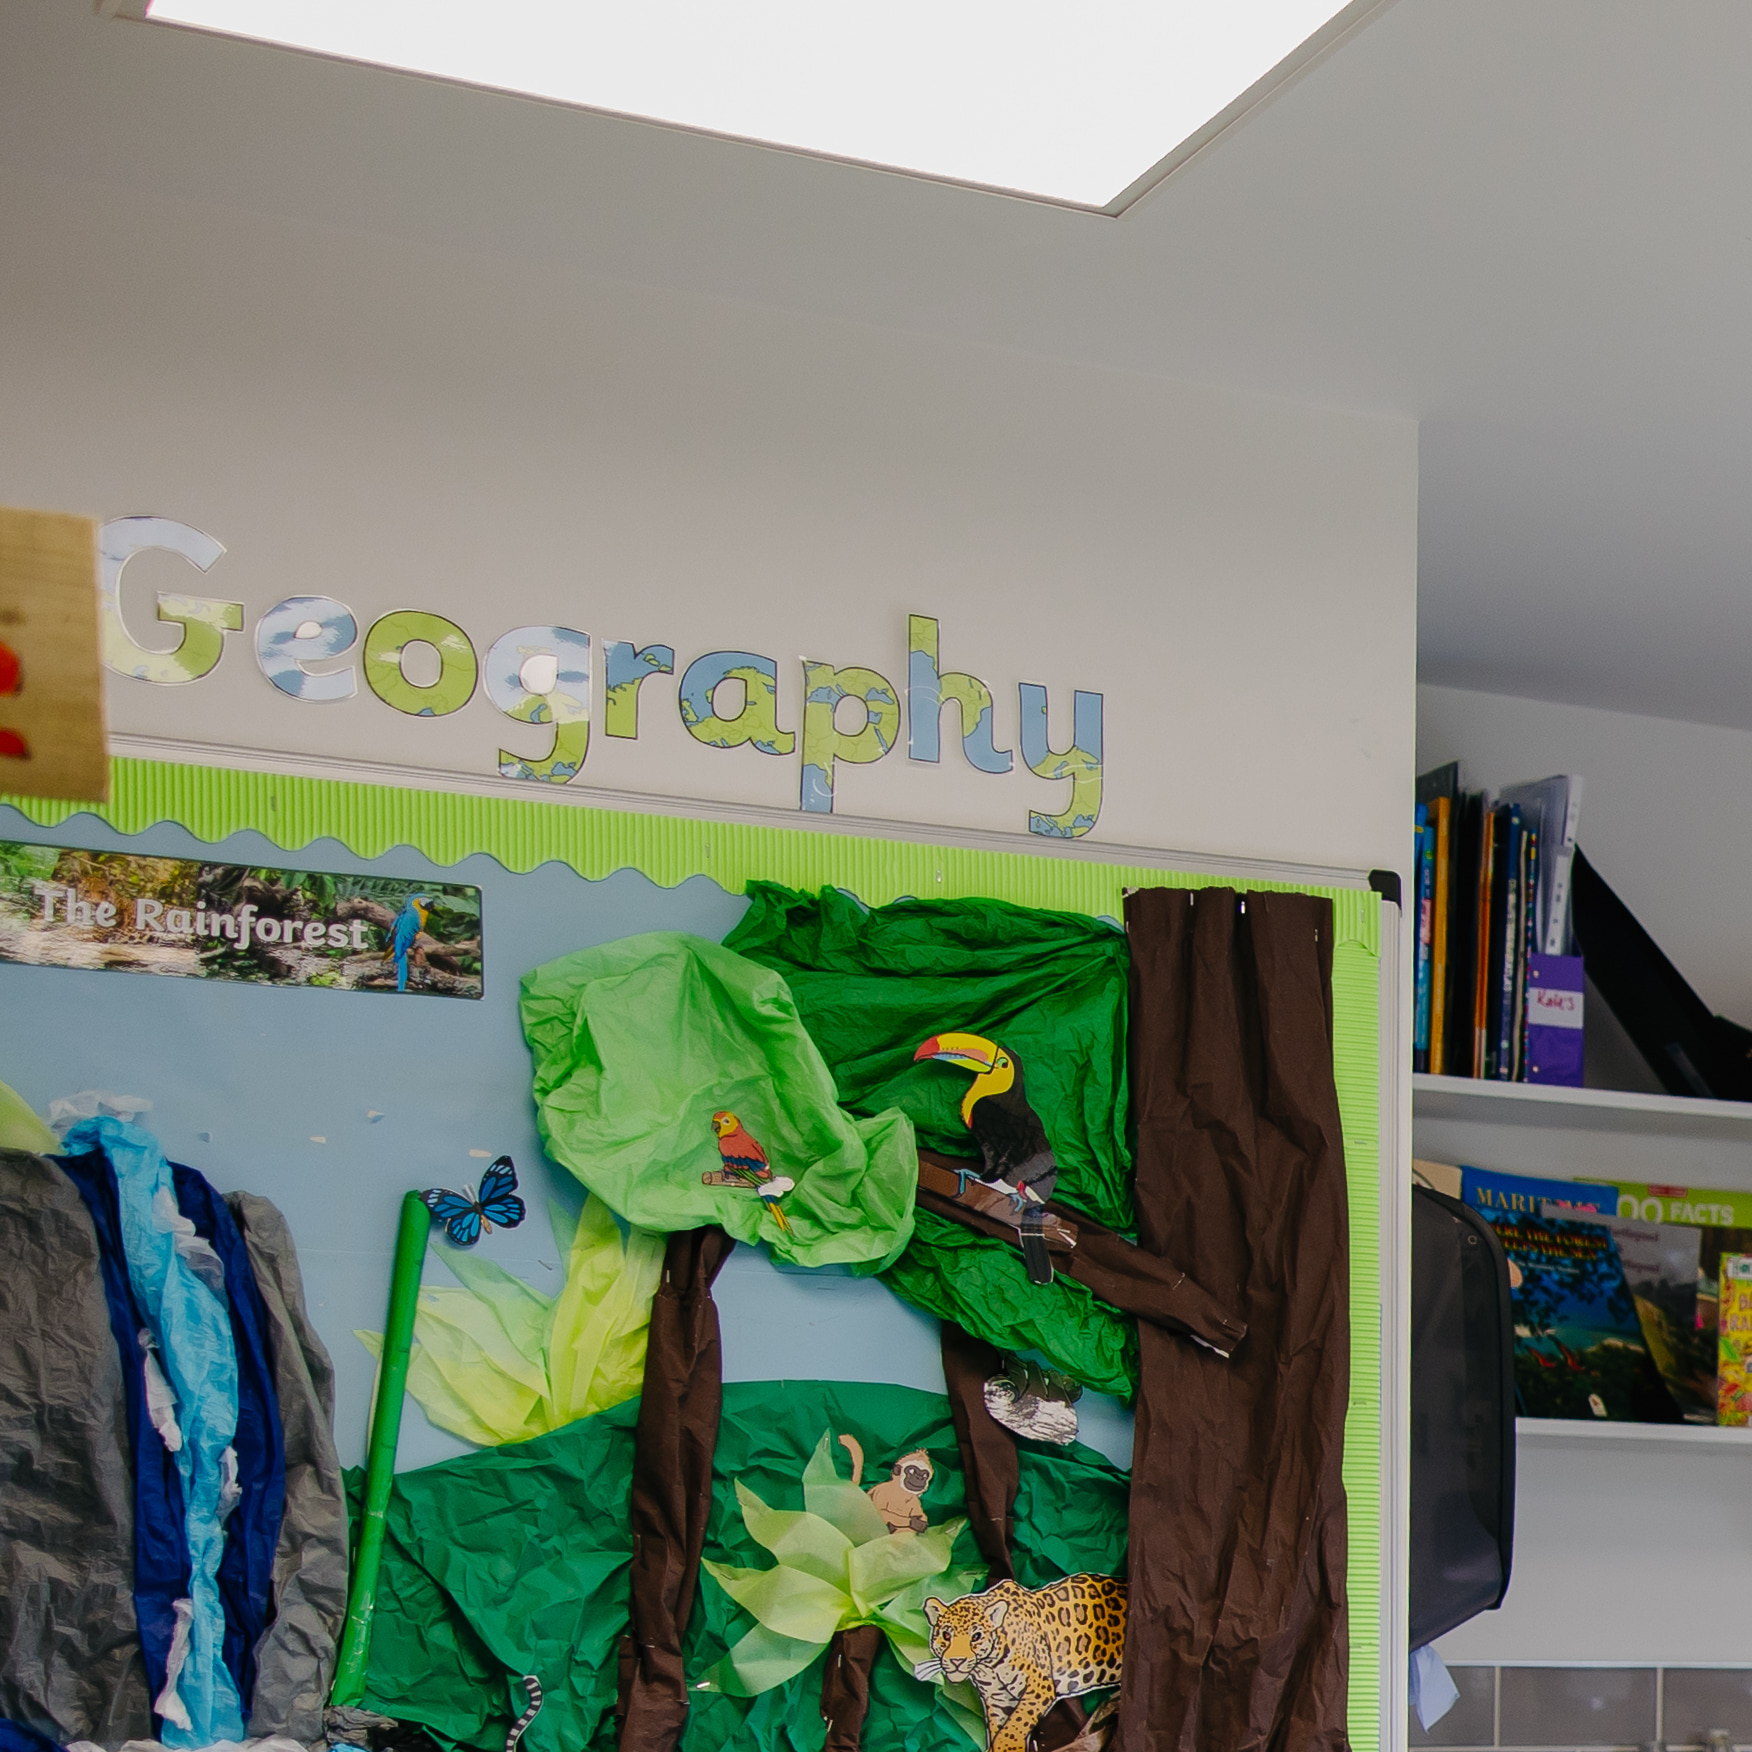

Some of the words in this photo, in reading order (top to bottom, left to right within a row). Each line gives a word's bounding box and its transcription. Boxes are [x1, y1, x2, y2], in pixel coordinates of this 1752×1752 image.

[98, 513, 1105, 842] Geography
[32, 886, 118, 927] The
[134, 898, 369, 951] Rainforest
[1669, 1201, 1734, 1227] FACTS
